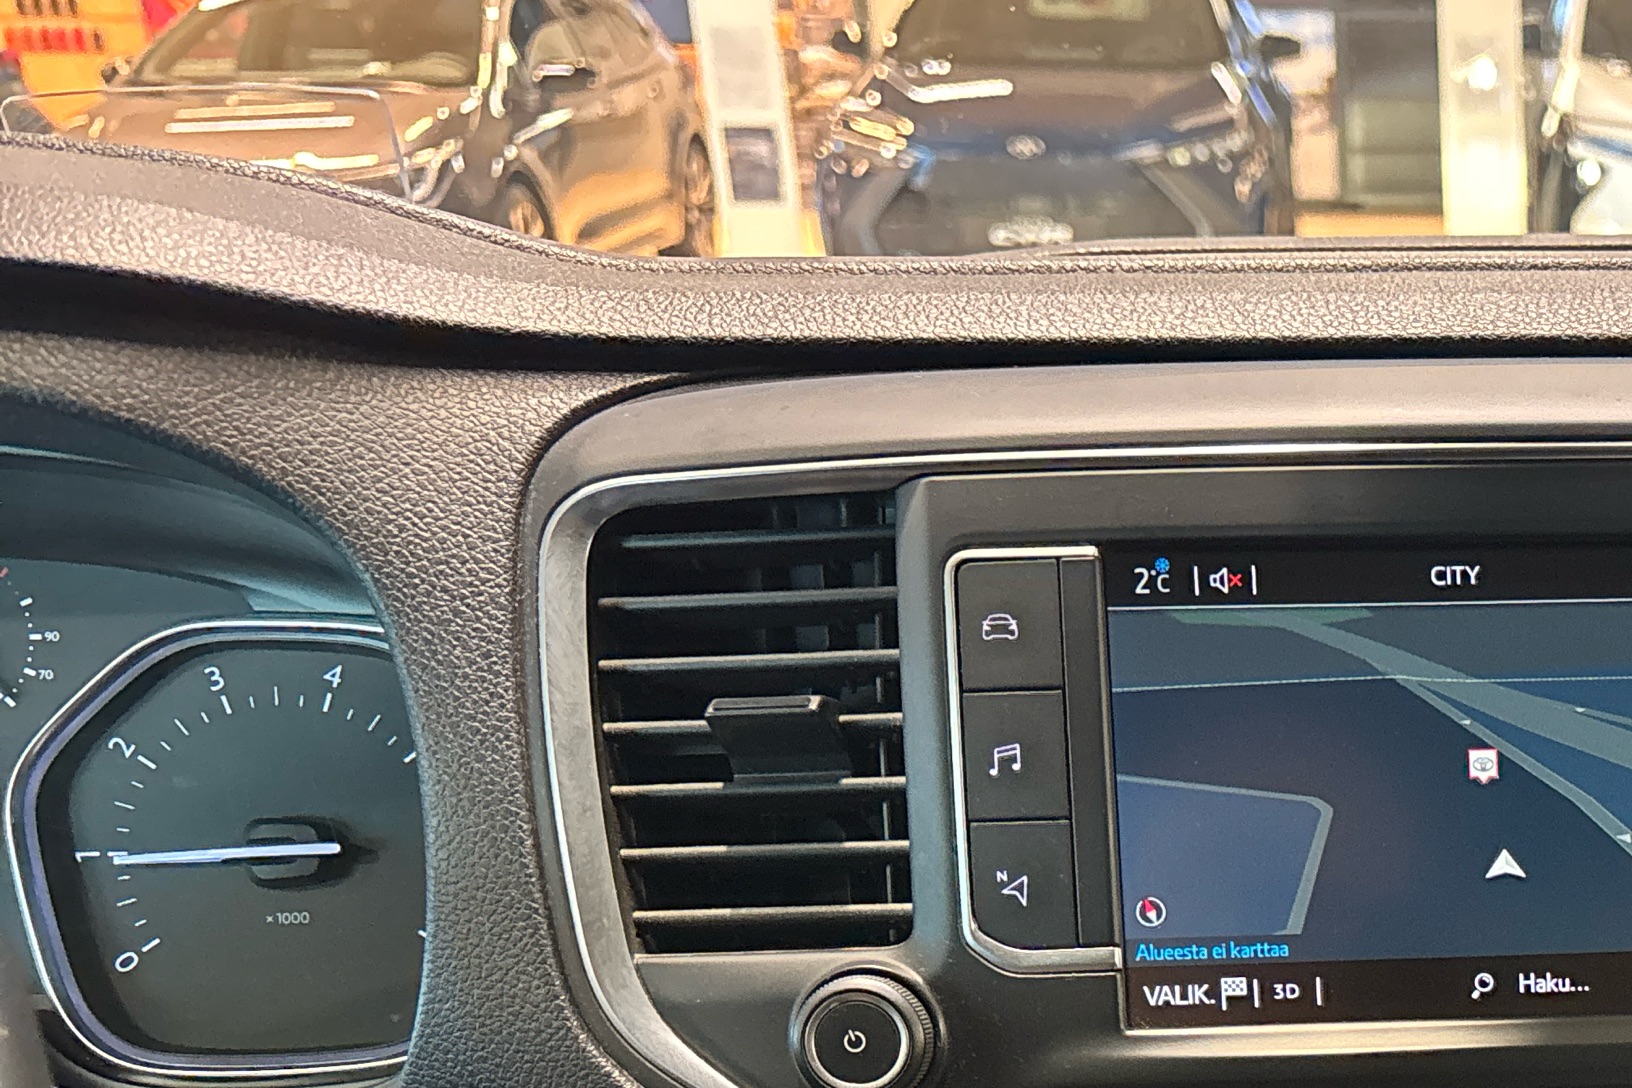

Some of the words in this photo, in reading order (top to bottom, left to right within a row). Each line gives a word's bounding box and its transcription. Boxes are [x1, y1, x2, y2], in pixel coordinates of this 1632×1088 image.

[1430, 565, 1481, 586] CITY
[44, 630, 60, 642] 90
[38, 669, 54, 680] 70
[203, 666, 226, 693] 3
[322, 664, 343, 688] 4
[107, 737, 136, 759] 2
[74, 850, 101, 863] 1
[996, 870, 1008, 883] N
[114, 950, 140, 974] 0
[1135, 943, 1208, 962] Alueesta
[1211, 943, 1227, 959] ei
[1229, 940, 1289, 959] karttaa
[1273, 983, 1300, 1000] 3D
[1518, 971, 1590, 994] Haku...
[1142, 983, 1216, 1007] VALIK.
